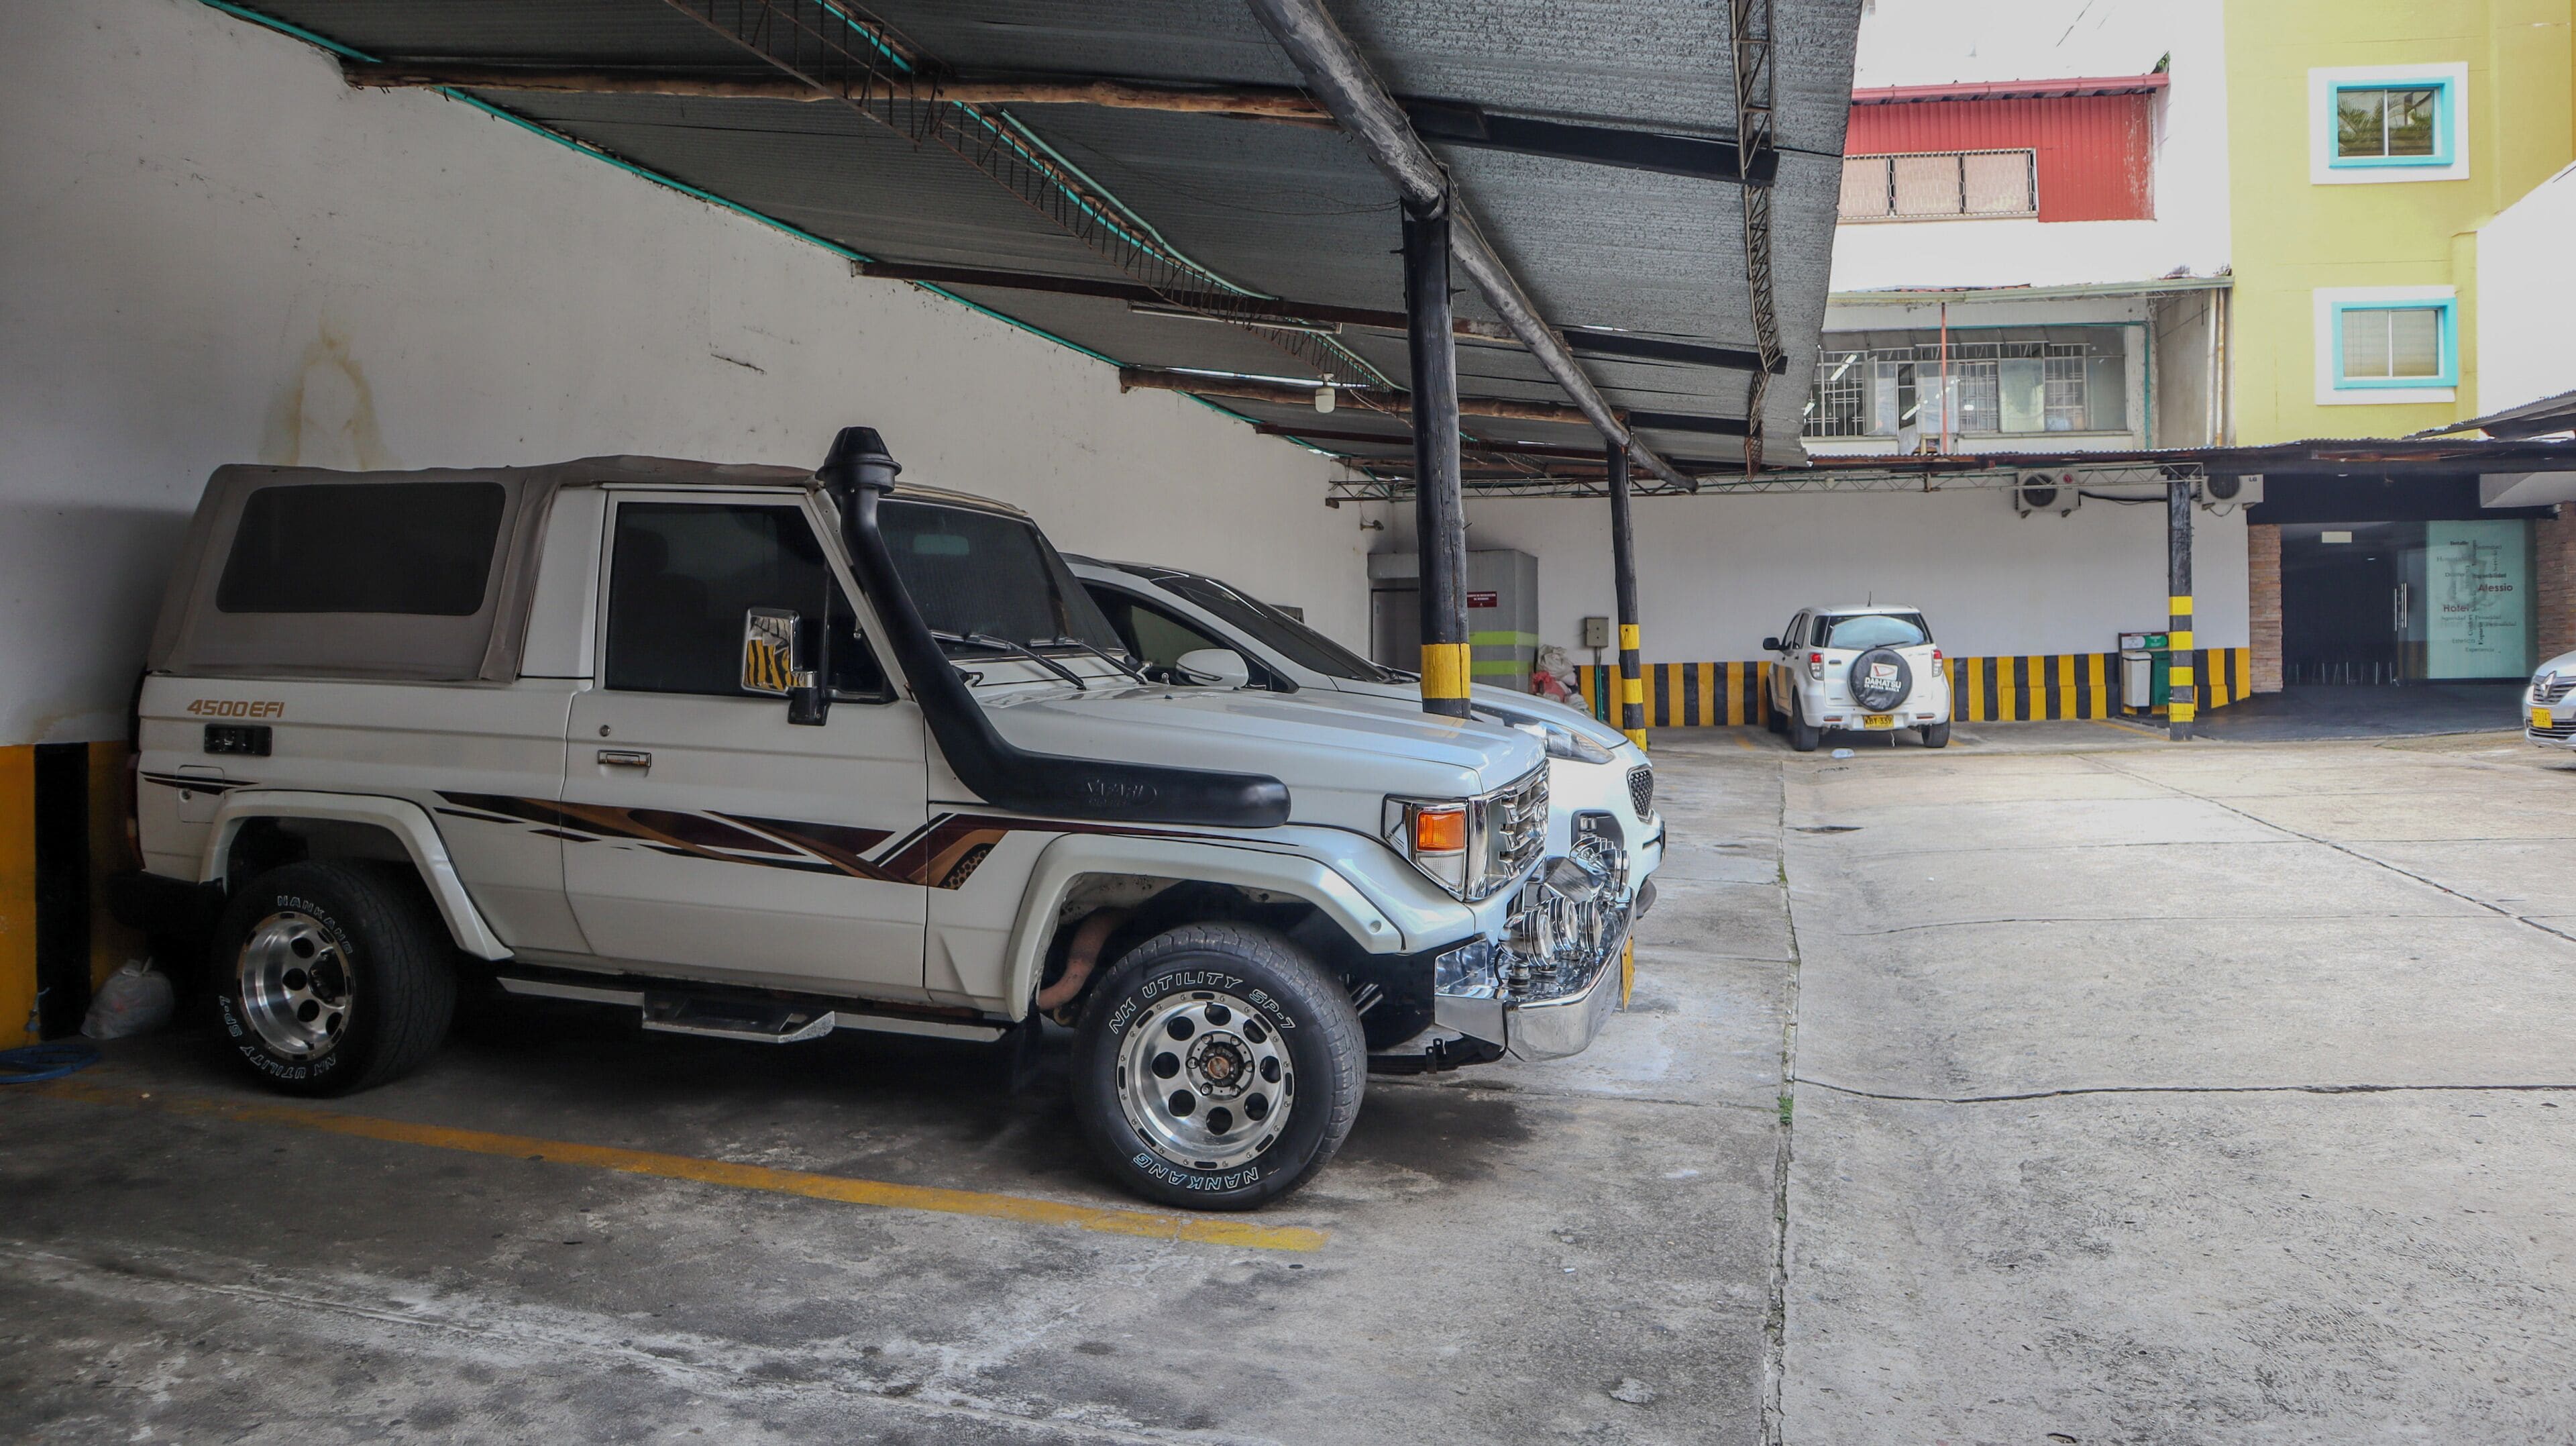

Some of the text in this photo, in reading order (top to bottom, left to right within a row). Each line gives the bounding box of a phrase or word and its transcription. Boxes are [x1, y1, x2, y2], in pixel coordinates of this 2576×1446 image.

[2478, 583, 2513, 592] Alessio
[2443, 605, 2469, 613] Hotel
[1865, 676, 1902, 688] DAIHATSU
[276, 895, 354, 954] NANKANG
[218, 995, 243, 1037] SP-7
[1108, 971, 1297, 1035] NK UTILITY SP-7
[239, 1045, 307, 1079] UTILITY
[1132, 1152, 1260, 1191] NANKANG
